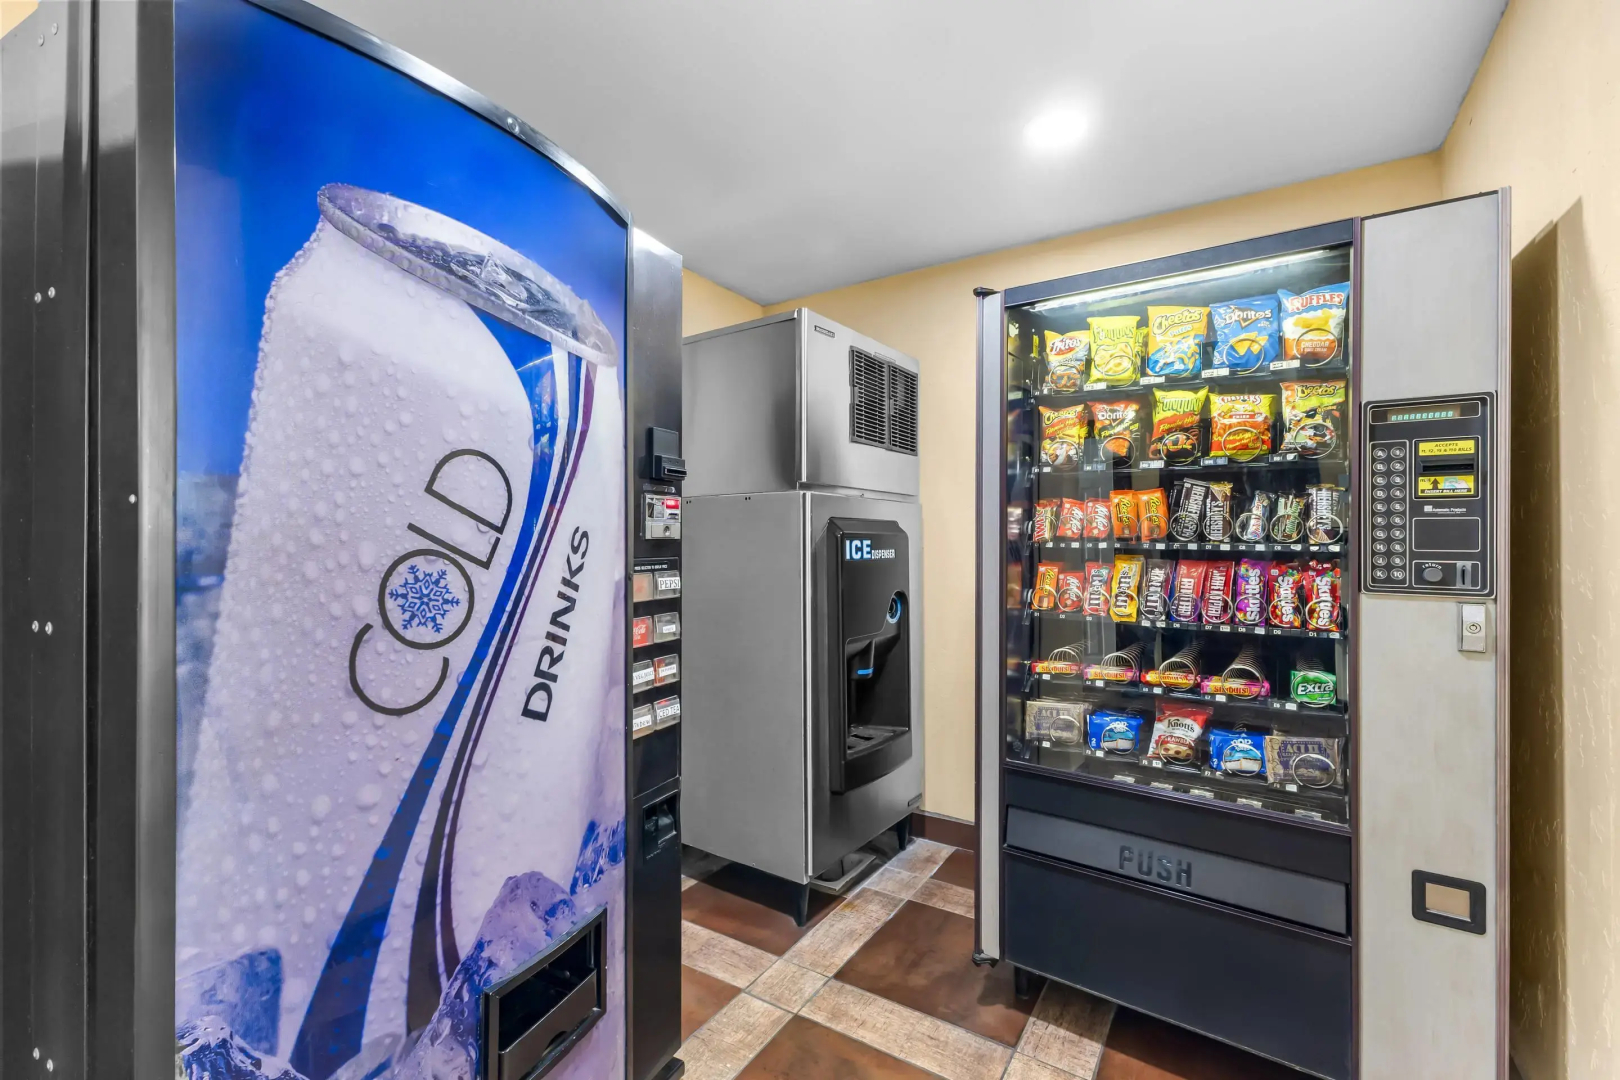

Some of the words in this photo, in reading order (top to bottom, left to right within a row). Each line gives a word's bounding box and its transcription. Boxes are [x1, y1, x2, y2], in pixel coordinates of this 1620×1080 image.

[1290, 292, 1344, 312] RUFFLES
[1154, 309, 1202, 334] Cheetos
[1226, 309, 1272, 324] Doritos
[1044, 410, 1078, 426] Cheetos
[1316, 490, 1332, 530] HERSHEY'S
[1210, 501, 1223, 539] HERSHEY'S
[846, 540, 871, 560] ICE
[872, 549, 896, 559] DISPENSER
[348, 448, 513, 716] COLD
[660, 578, 680, 588] PEPSI
[521, 526, 590, 722] DRINKS
[1094, 671, 1125, 679] Starburst
[1298, 682, 1333, 694] Extra
[671, 705, 680, 714] TEA
[1168, 719, 1195, 733] Knott's
[1286, 744, 1305, 753] ACT
[1307, 745, 1319, 753] II
[1119, 845, 1192, 889] PUSH
